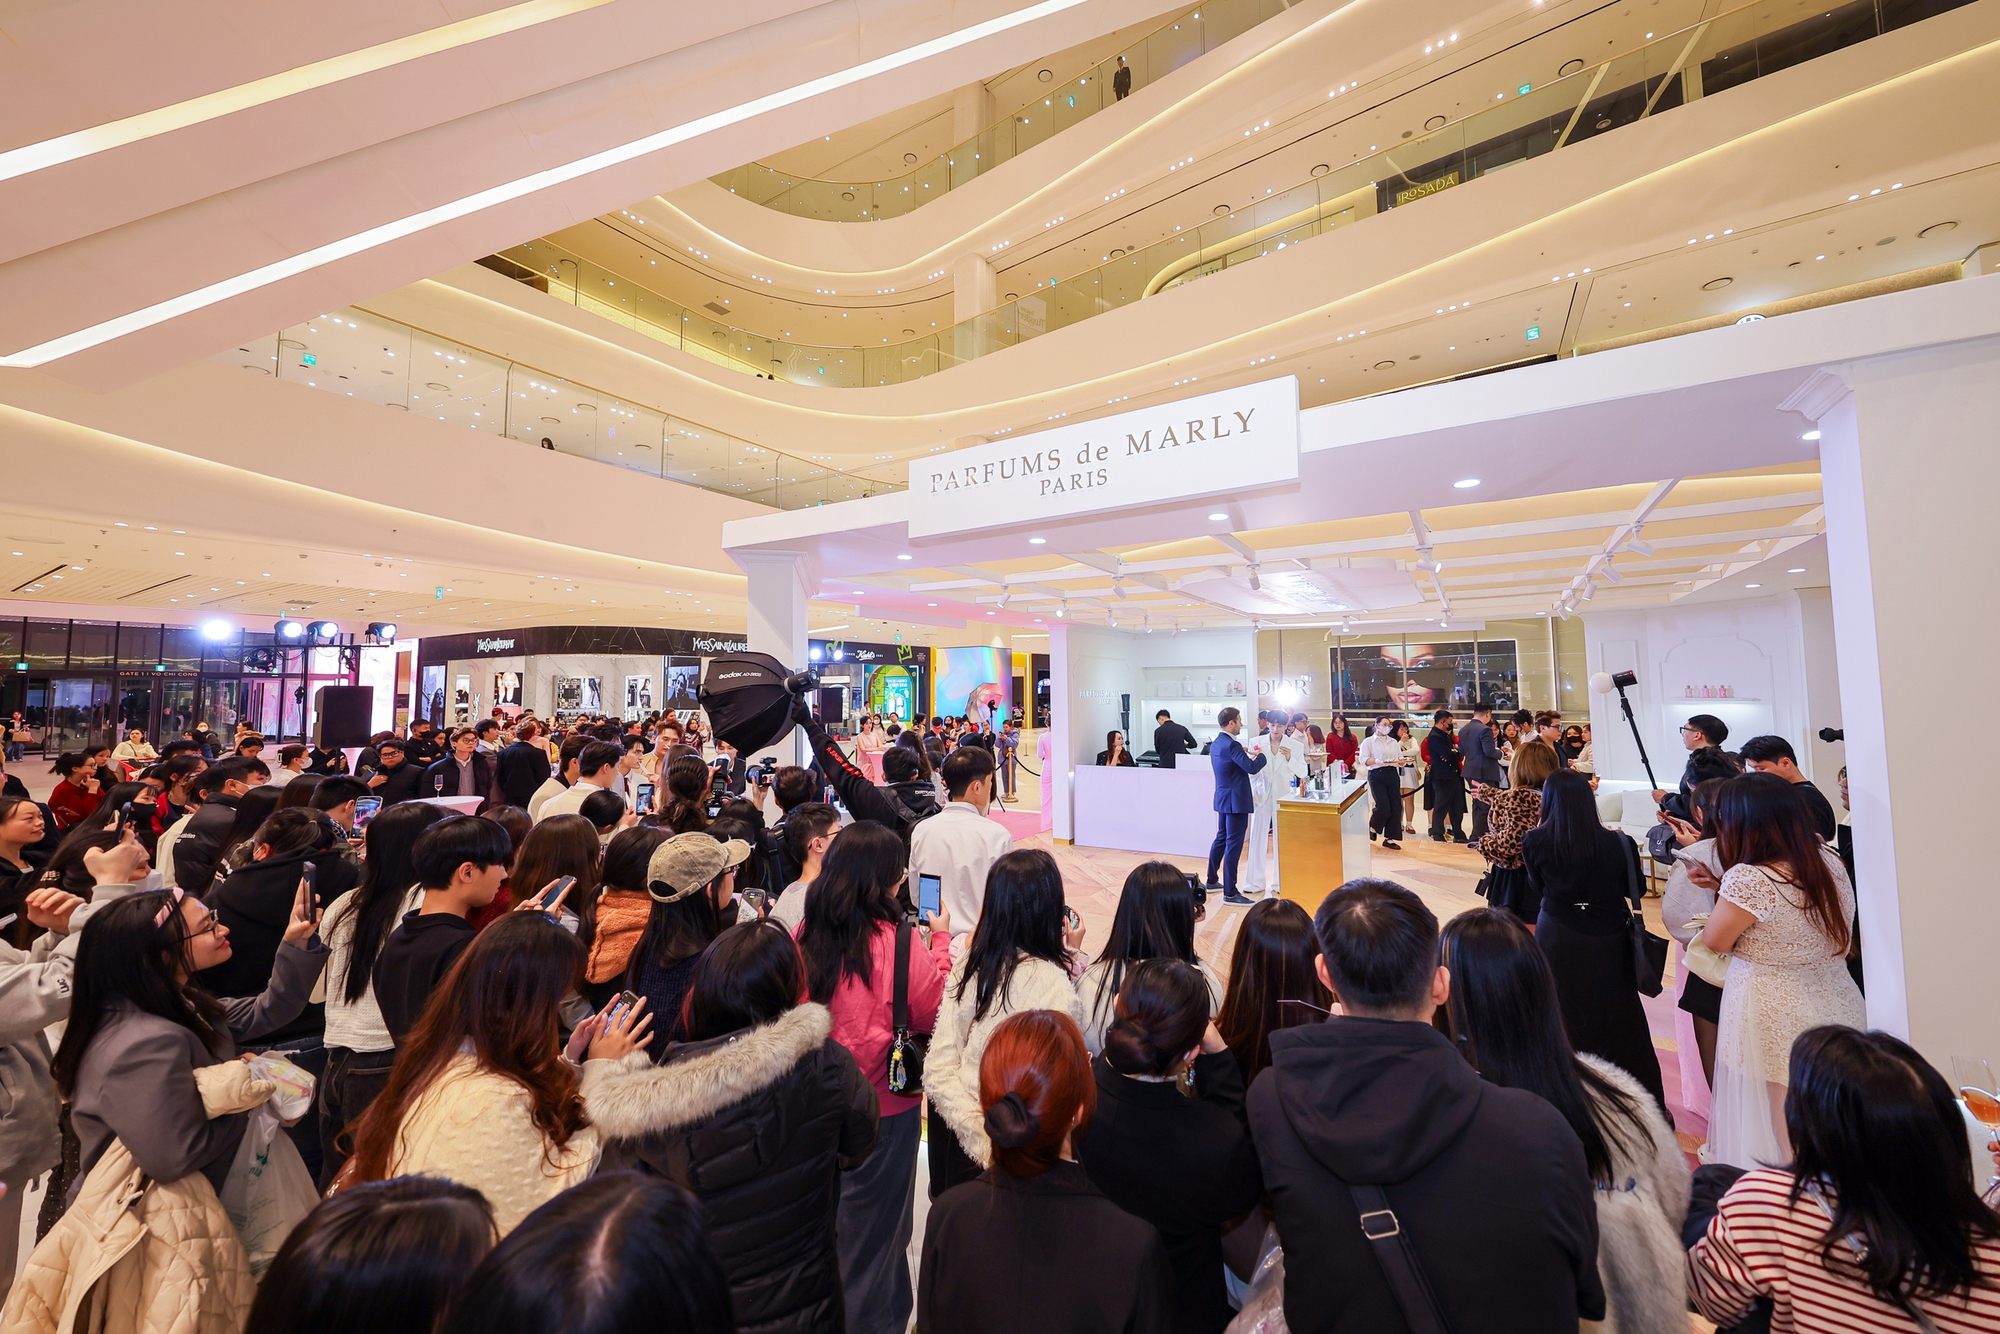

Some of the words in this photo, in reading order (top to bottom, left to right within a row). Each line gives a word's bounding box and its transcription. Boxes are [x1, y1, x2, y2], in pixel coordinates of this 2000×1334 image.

[931, 449, 1061, 493] PARFUMS
[1077, 442, 1108, 465] de
[1126, 407, 1255, 456] MARLY
[1040, 468, 1108, 496] PARIS
[1257, 679, 1310, 696] DIOR
